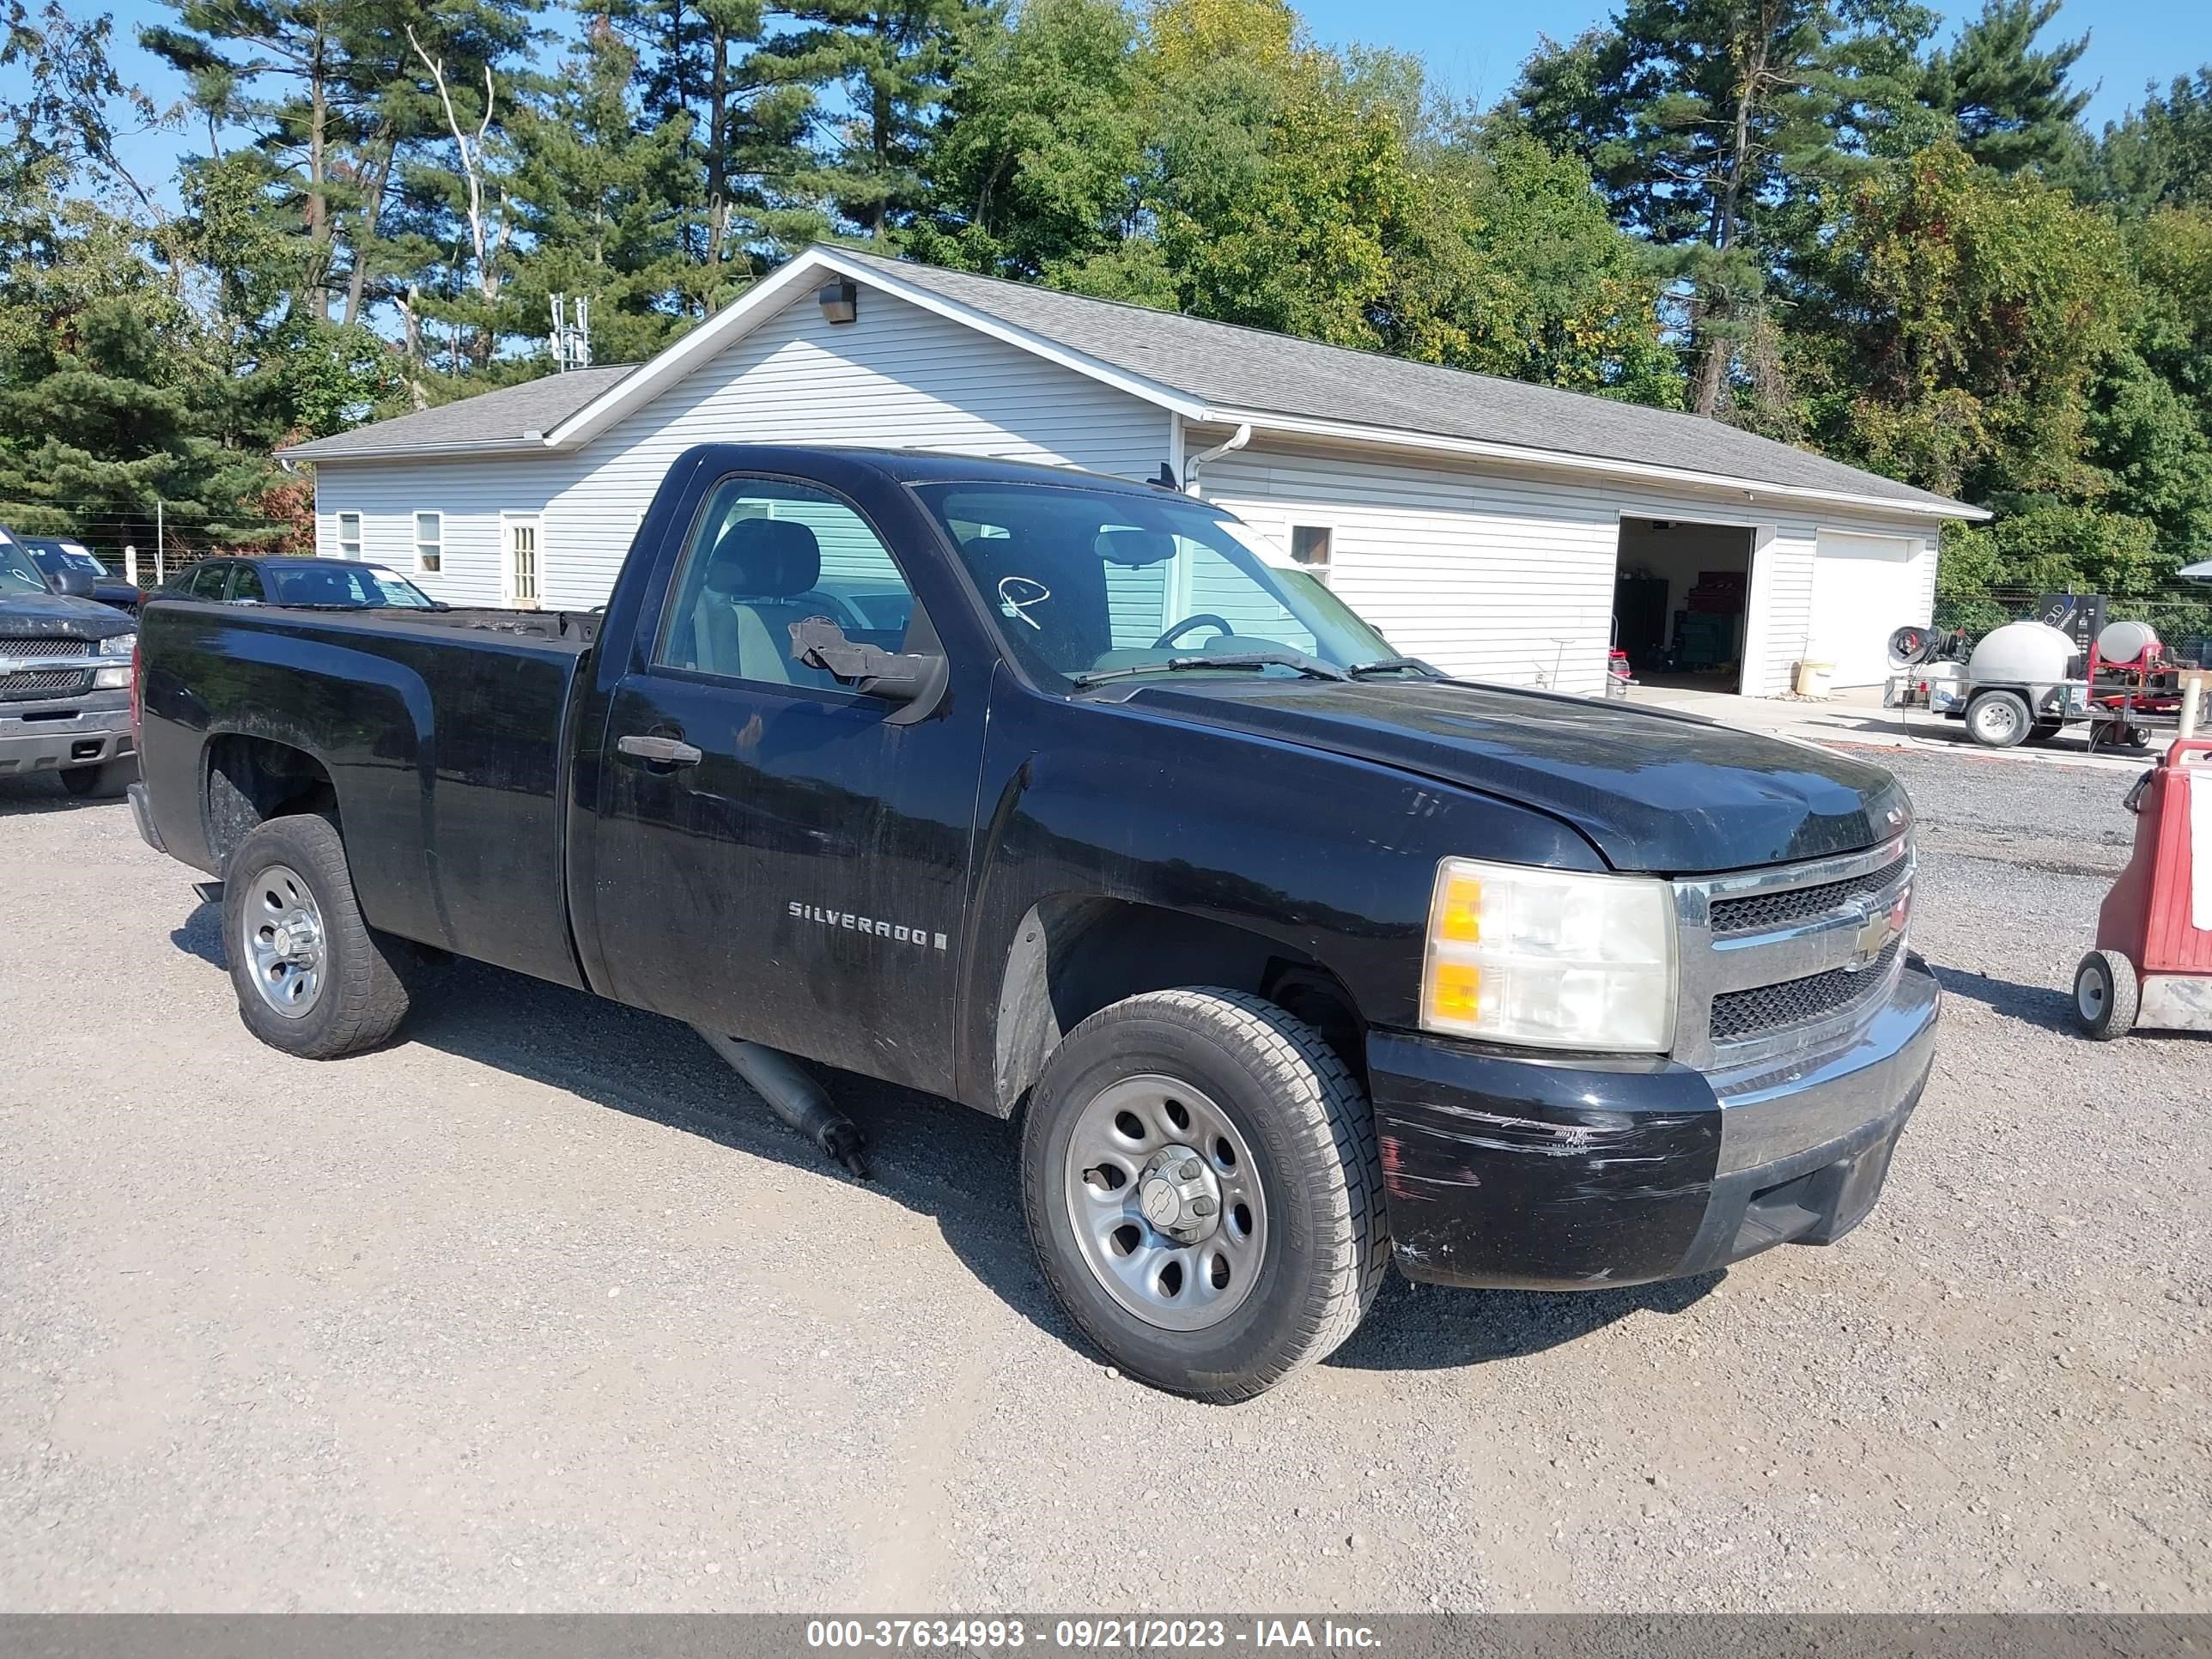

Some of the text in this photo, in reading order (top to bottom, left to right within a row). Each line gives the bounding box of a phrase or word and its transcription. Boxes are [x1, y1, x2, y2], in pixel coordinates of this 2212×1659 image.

[2042, 605, 2064, 625] OLD
[2057, 609, 2077, 630] DRINKS
[788, 901, 927, 946] SILVERADO
[1251, 1108, 1307, 1254] COOPER
